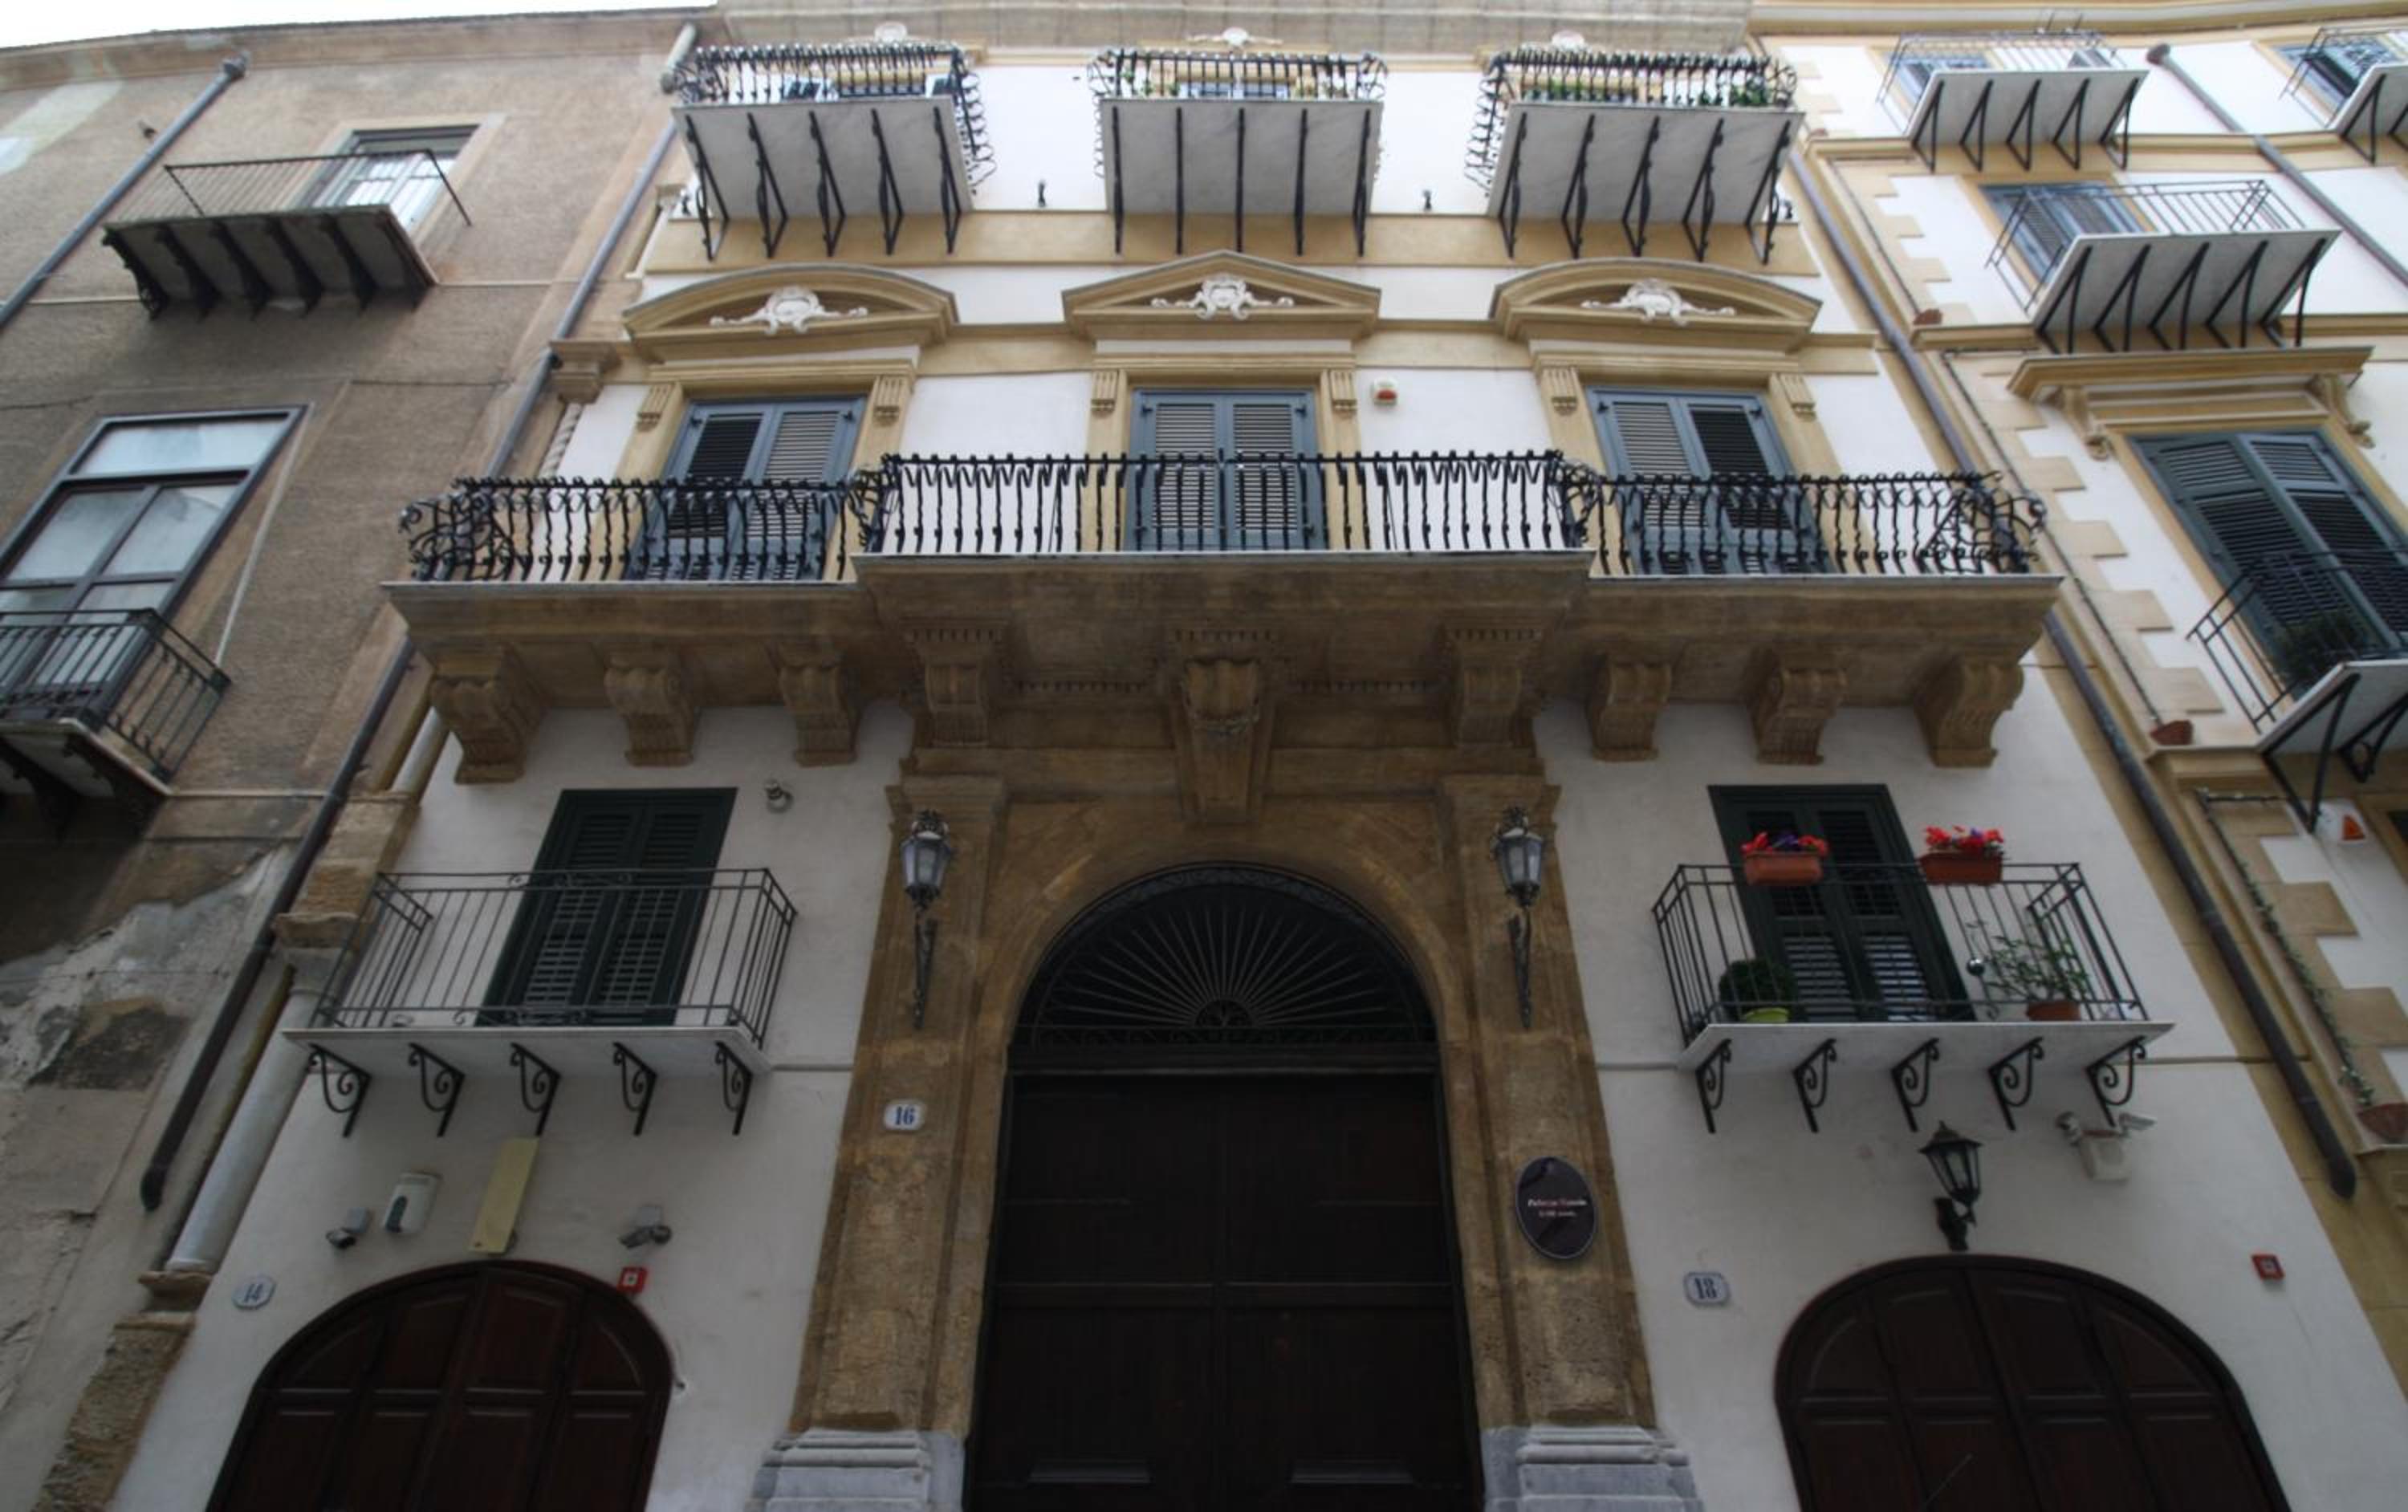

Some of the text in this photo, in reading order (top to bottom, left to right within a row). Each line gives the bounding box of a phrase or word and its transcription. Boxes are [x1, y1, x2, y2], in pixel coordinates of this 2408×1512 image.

[895, 1105, 915, 1125] 16
[244, 1282, 263, 1303] 14
[1694, 1277, 1718, 1299] 18
